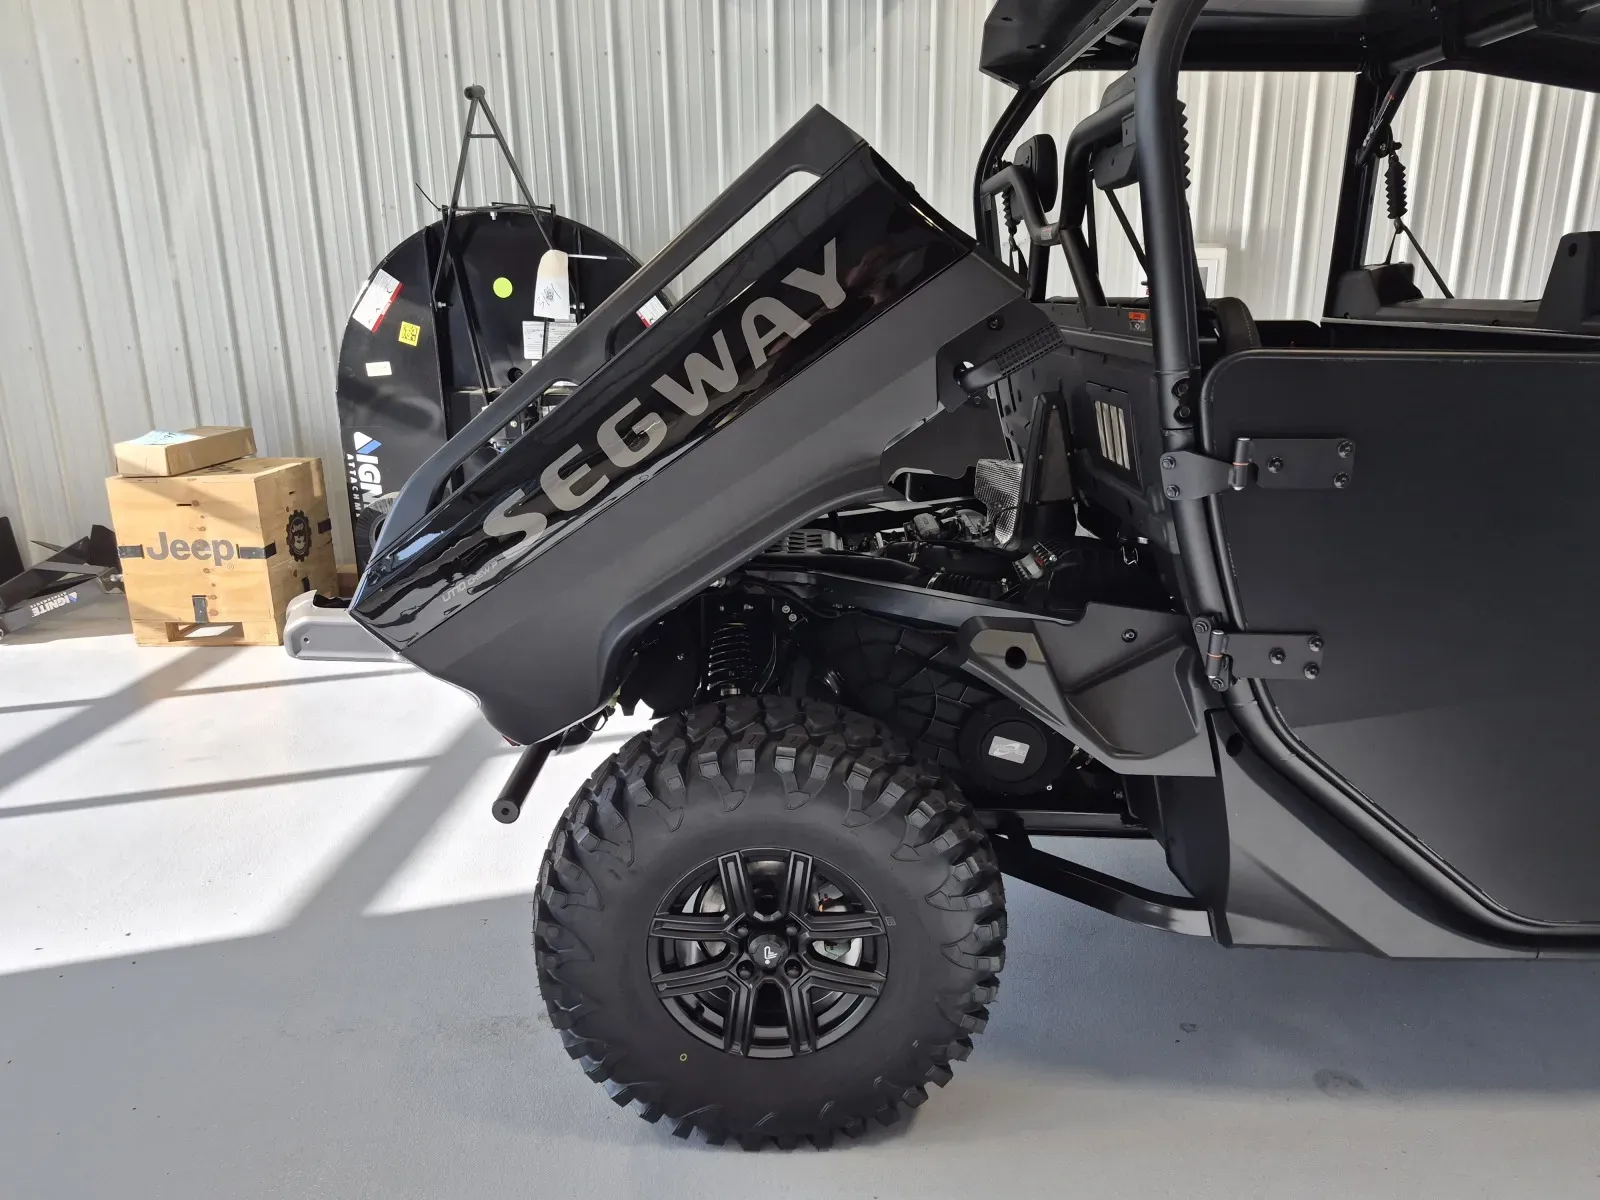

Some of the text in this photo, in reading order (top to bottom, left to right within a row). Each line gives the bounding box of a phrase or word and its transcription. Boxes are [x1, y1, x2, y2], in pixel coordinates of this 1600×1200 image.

[482, 237, 848, 560] SEGWAY
[356, 454, 384, 508] IGN
[146, 531, 235, 566] Jeep
[467, 566, 490, 586] CREW
[31, 595, 71, 617] IGNITE
